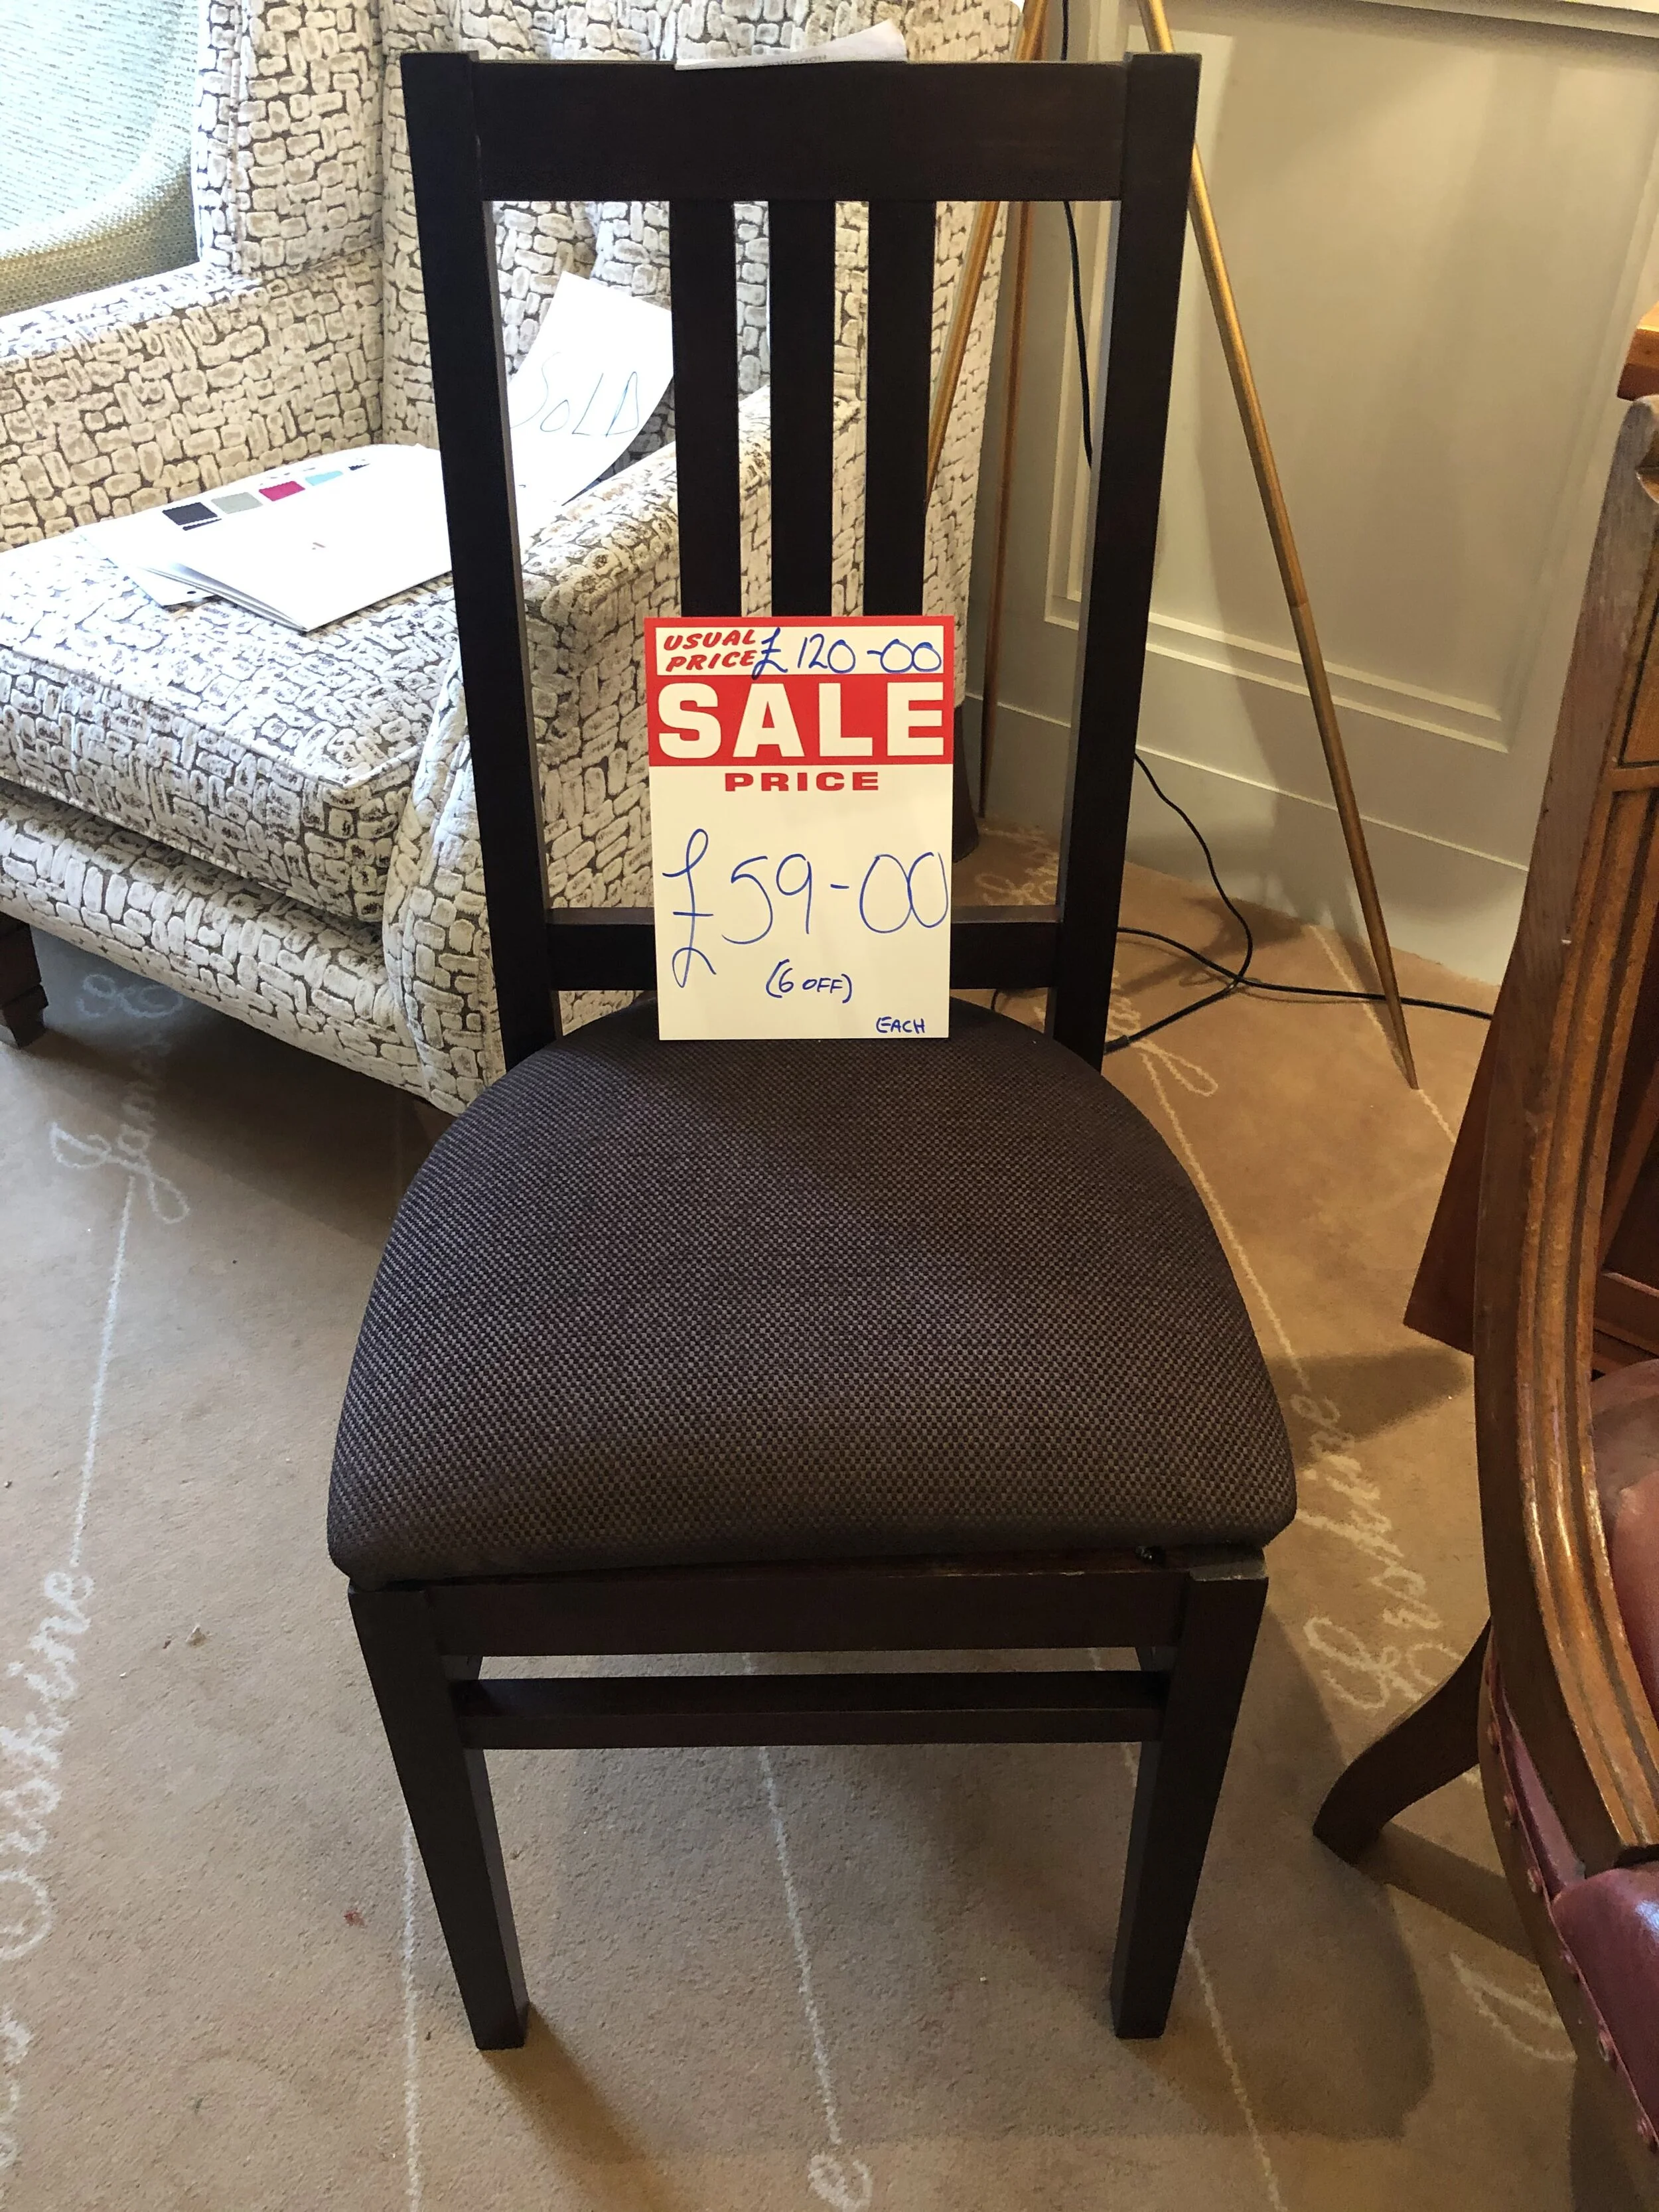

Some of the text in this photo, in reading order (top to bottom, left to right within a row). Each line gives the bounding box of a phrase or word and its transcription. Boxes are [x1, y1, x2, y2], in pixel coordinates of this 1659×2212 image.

[664, 629, 755, 651] USUAL
[666, 650, 755, 672] PRICE
[658, 681, 944, 759] SALE
[724, 771, 879, 792] PRICE
[875, 1016, 926, 1034] EACH
